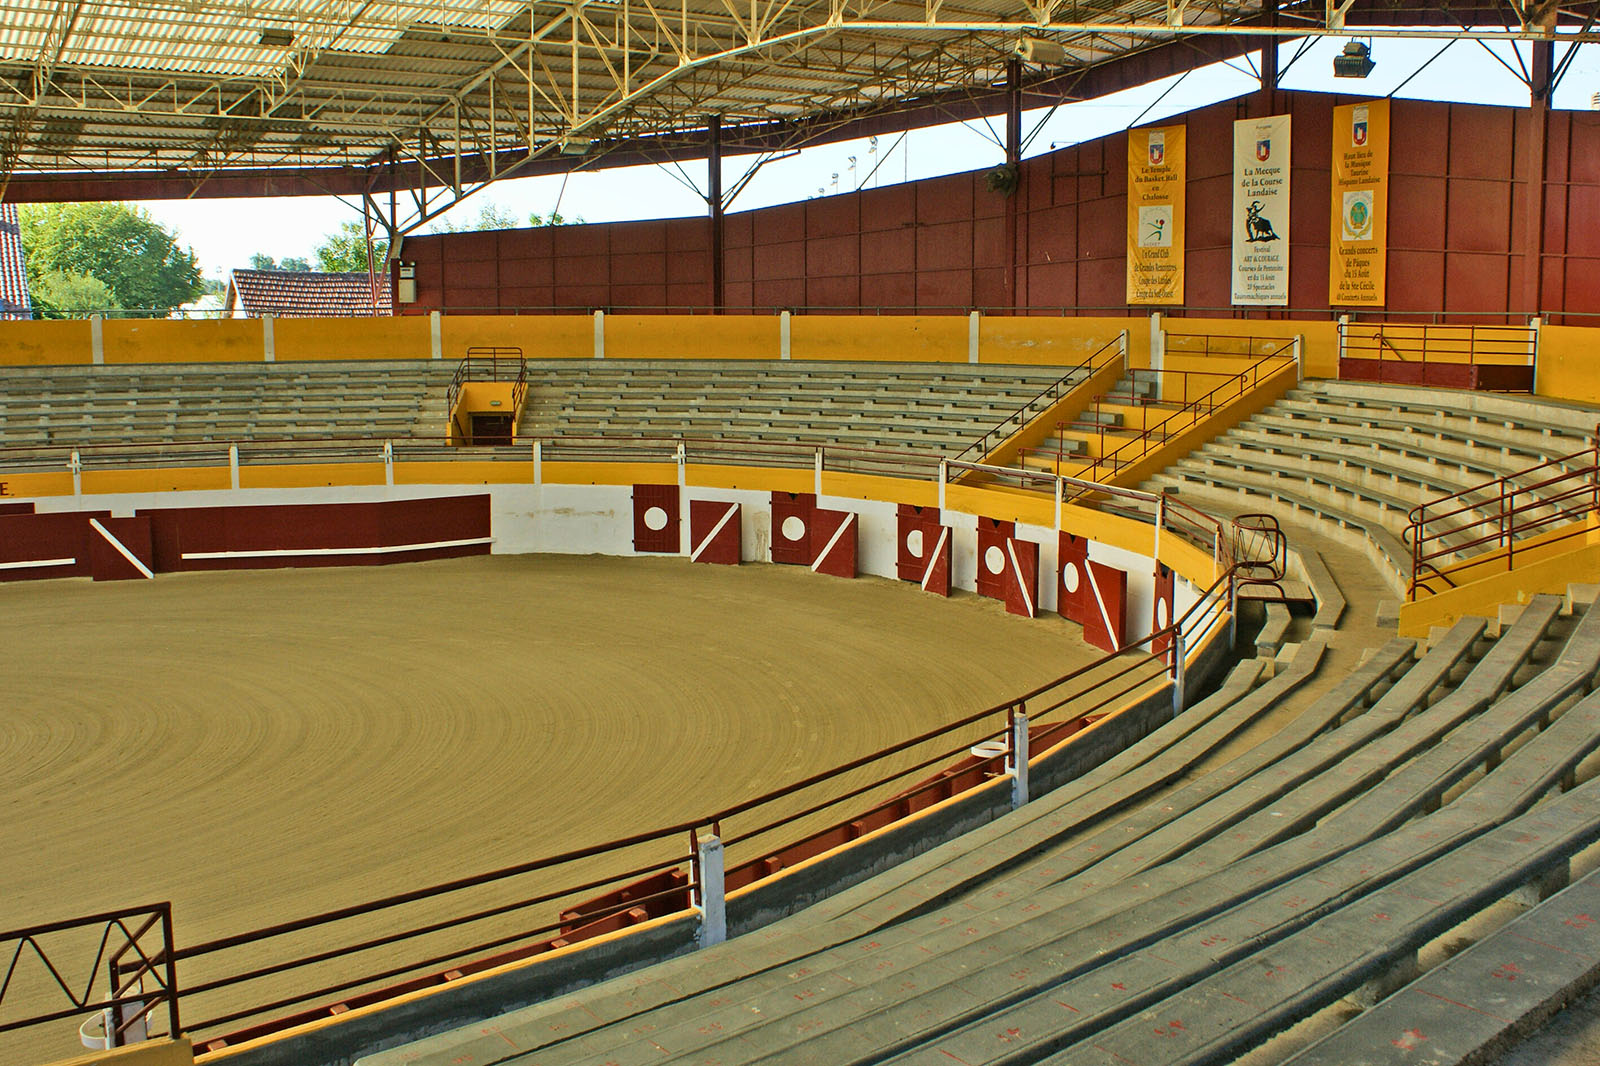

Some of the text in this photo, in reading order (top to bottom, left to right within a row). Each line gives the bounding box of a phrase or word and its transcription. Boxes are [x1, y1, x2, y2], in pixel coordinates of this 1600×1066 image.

[1245, 168, 1281, 176] La Mecque
[1260, 178, 1283, 186] Course
[1248, 188, 1278, 197] Landaise
[1339, 246, 1378, 255] Grands concerts
